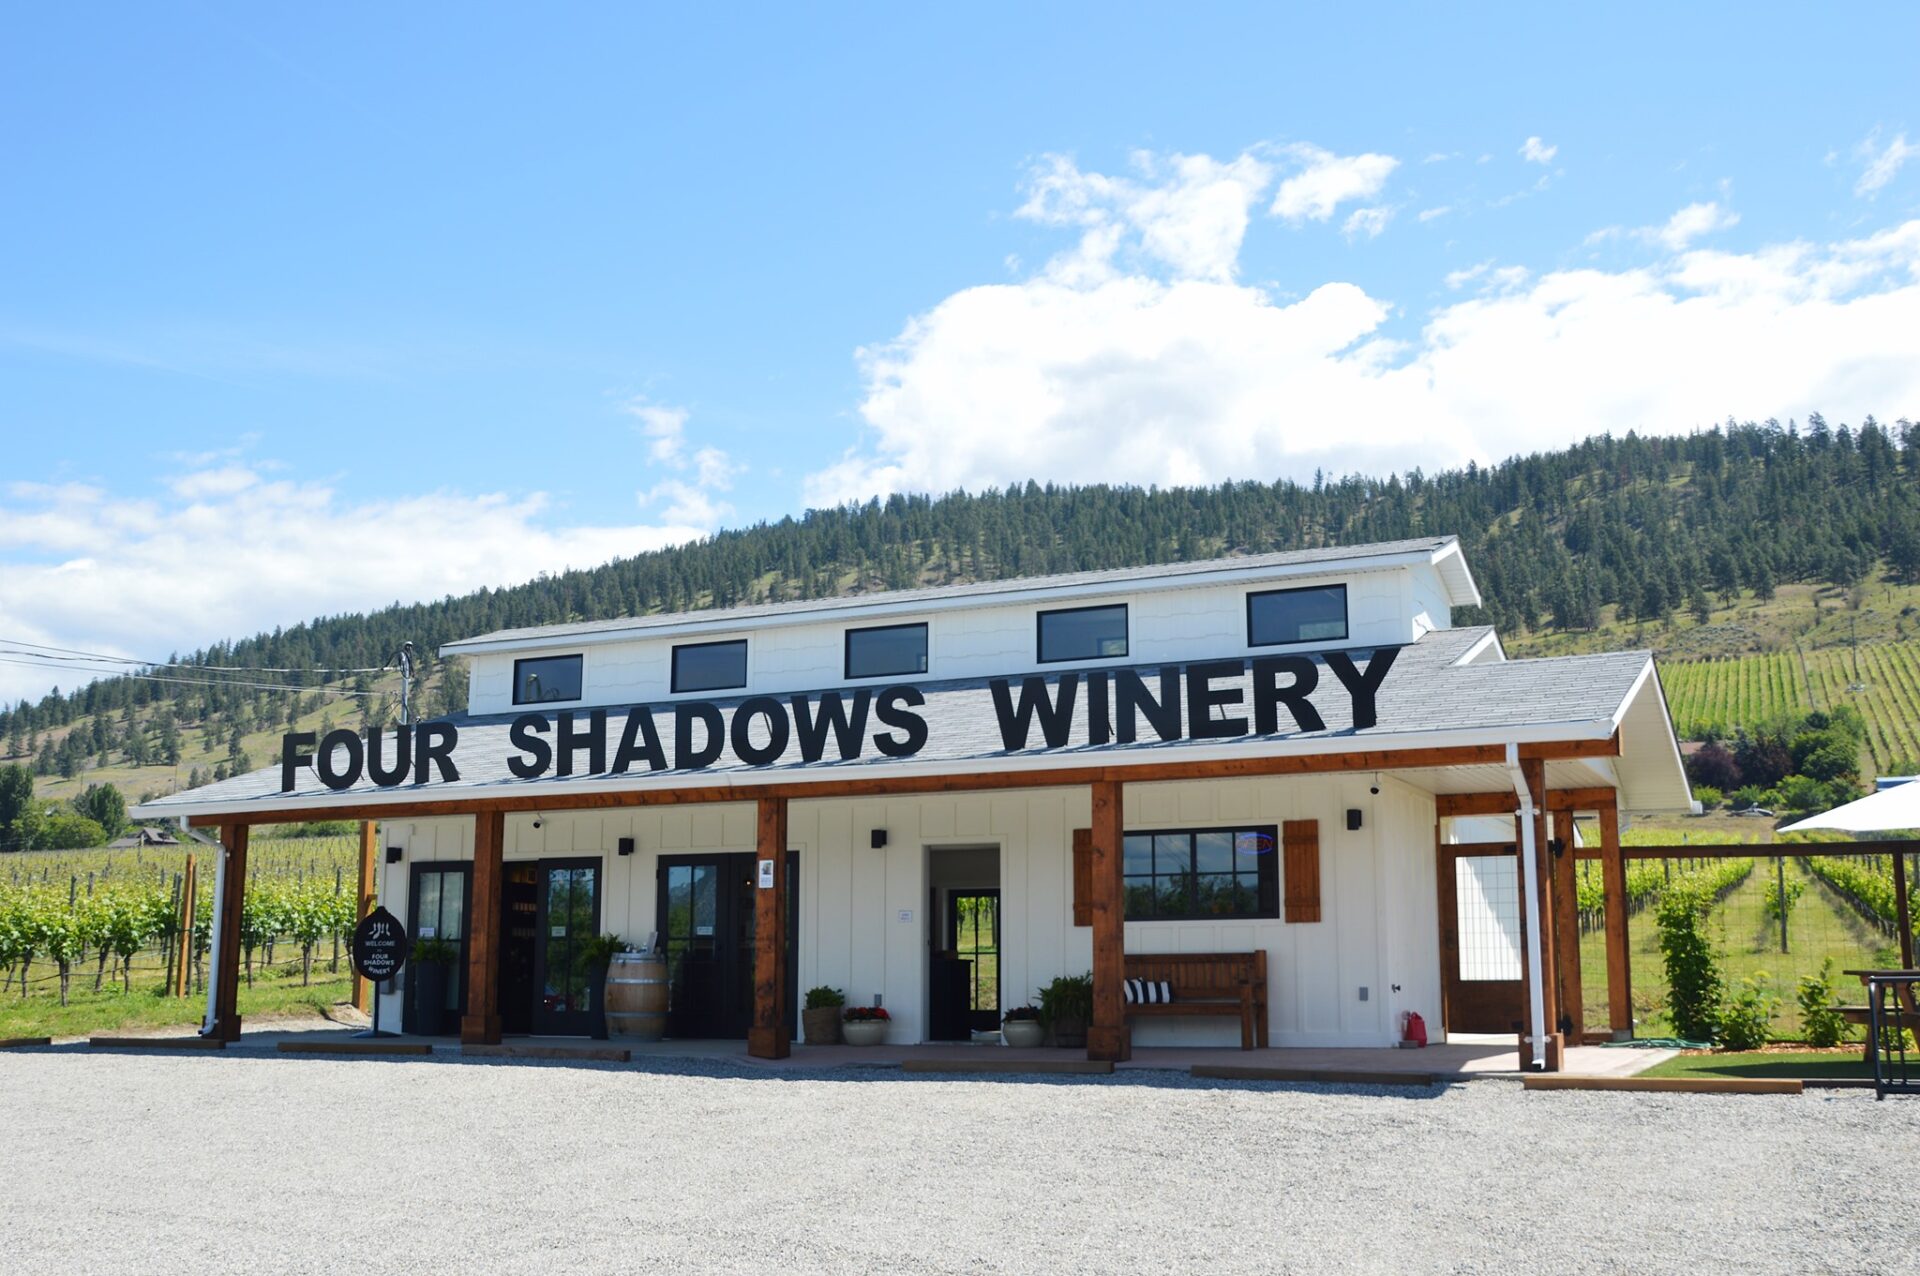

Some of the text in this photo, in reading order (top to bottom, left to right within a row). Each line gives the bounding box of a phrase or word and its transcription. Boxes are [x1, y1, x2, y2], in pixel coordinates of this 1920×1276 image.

[281, 647, 1400, 793] FOUR SHADOWS WINERY
[368, 966, 391, 974] WINERY
